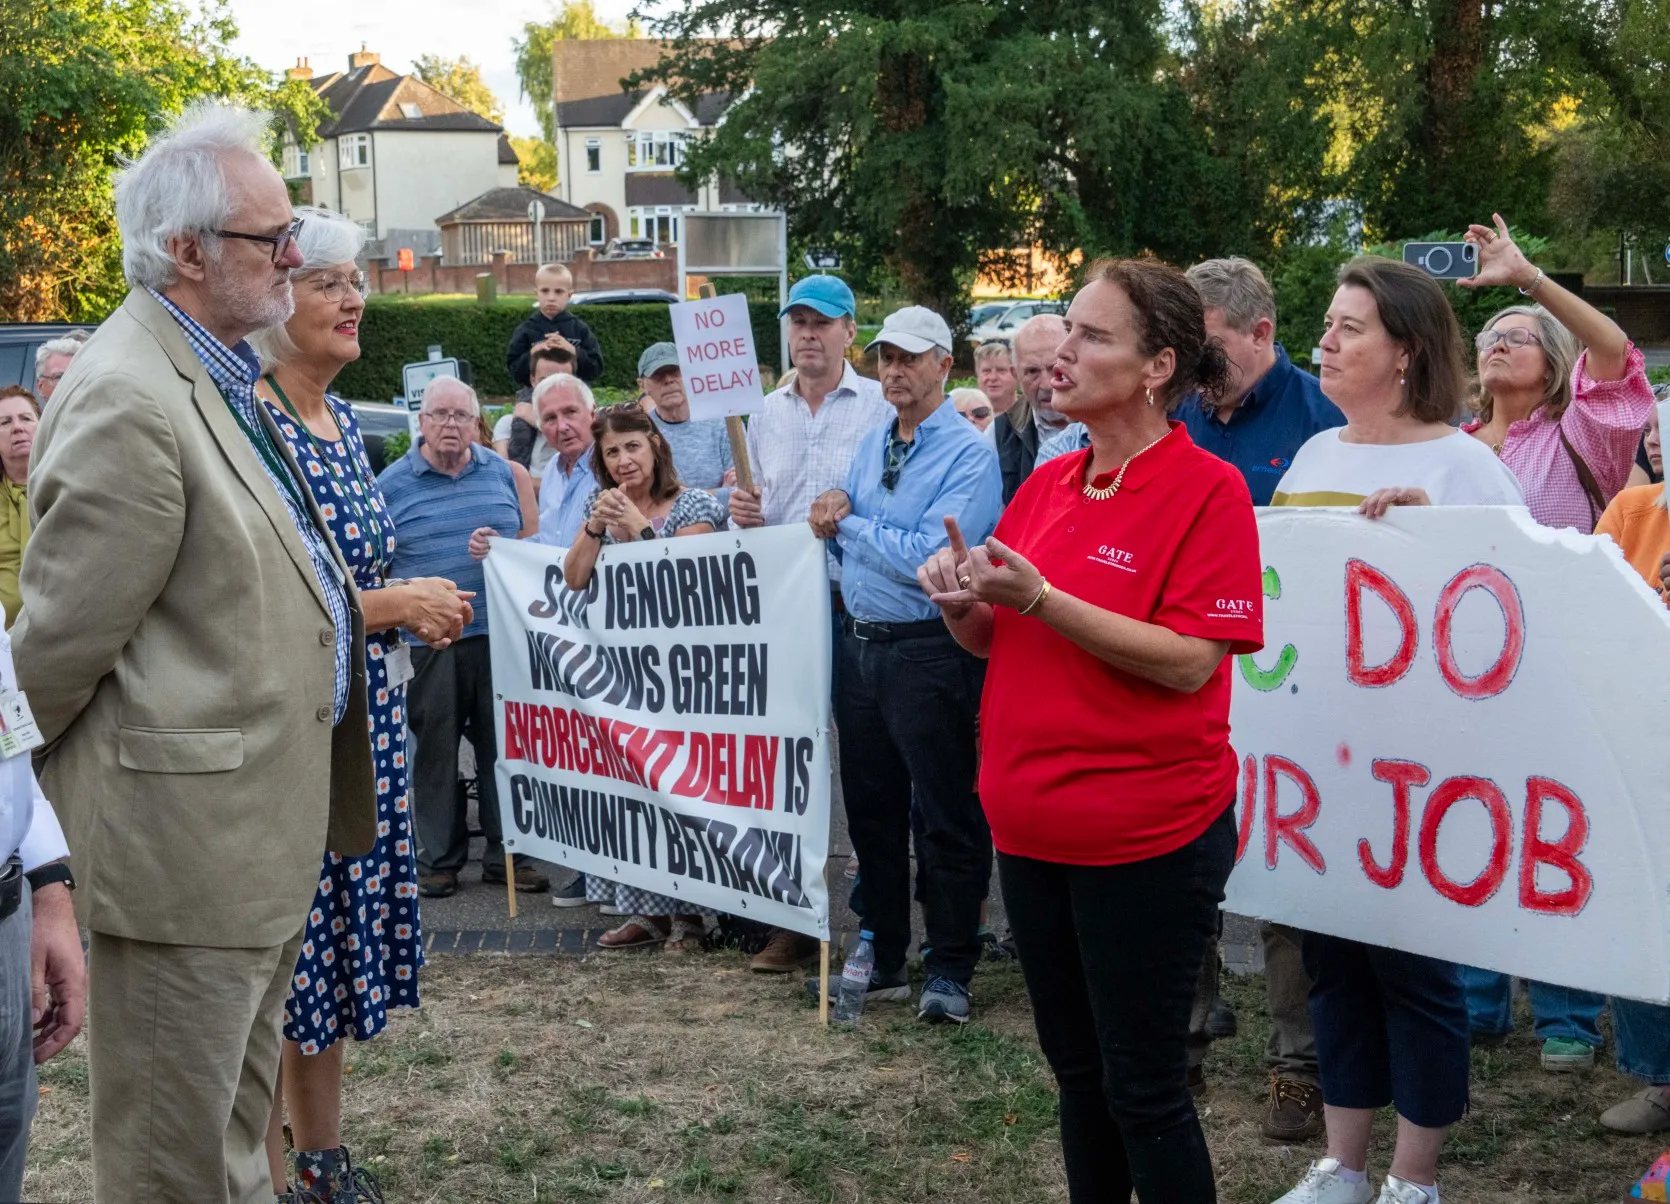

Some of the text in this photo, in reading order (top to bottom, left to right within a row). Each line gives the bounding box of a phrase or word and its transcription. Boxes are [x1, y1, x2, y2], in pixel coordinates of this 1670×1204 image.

[686, 337, 747, 364] MORE
[694, 309, 725, 330] NO
[690, 368, 754, 395] DELAY
[604, 551, 761, 632] IGNORING
[1098, 544, 1134, 563] GATE
[1215, 598, 1254, 612] GATE
[1345, 557, 1526, 702] DO
[526, 629, 768, 717] WILLOWS GREEN
[504, 700, 814, 817] ENFORCEMENT DELAY IS
[510, 773, 658, 870] COMMUNITY
[1357, 757, 1595, 918] JOB
